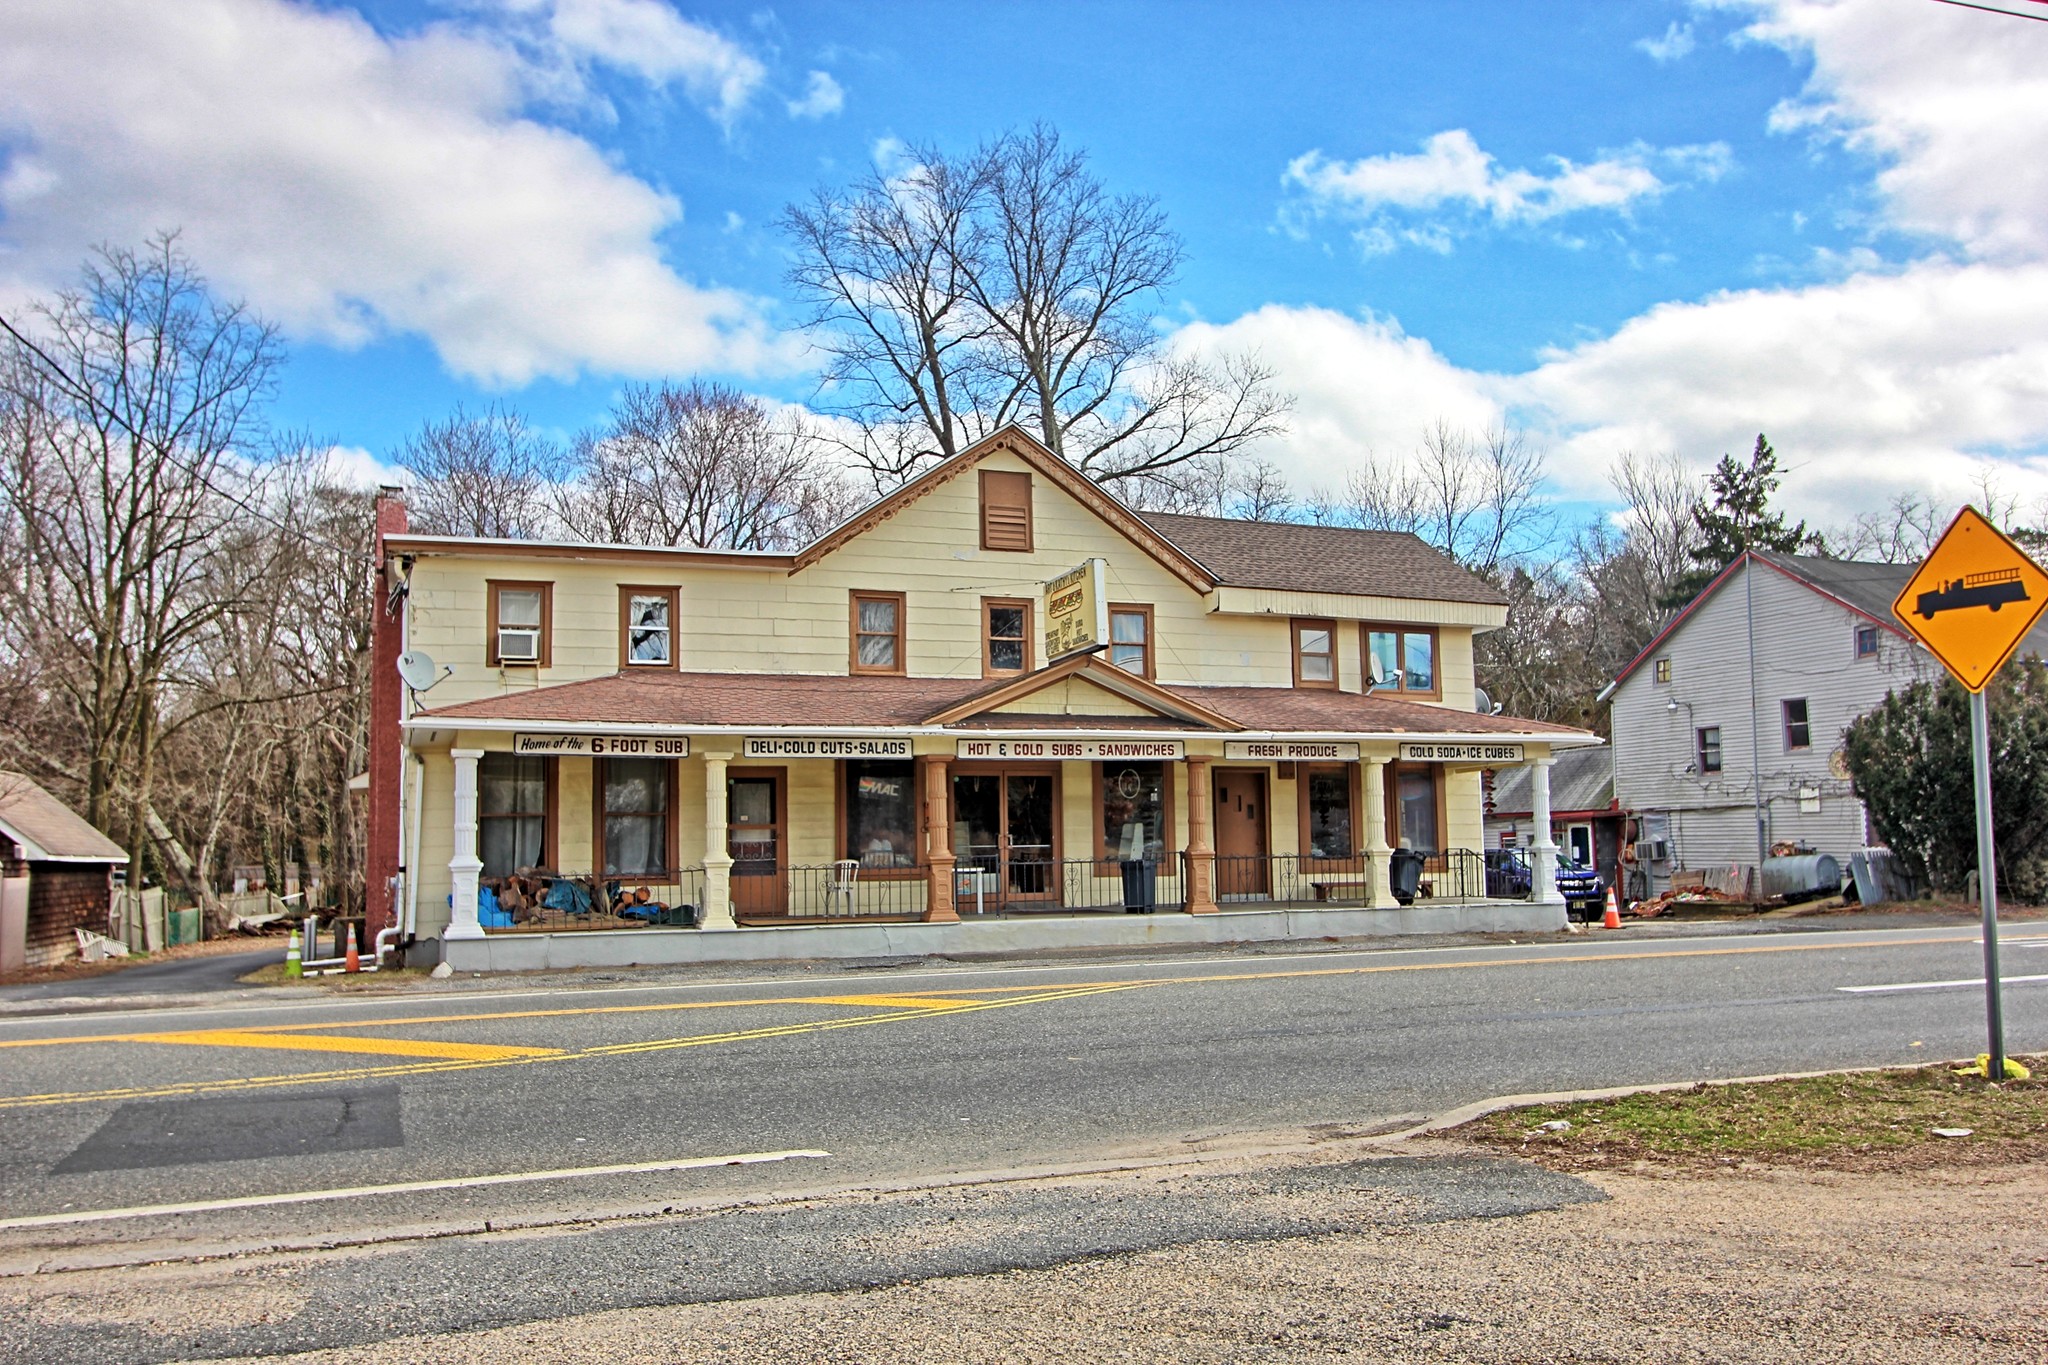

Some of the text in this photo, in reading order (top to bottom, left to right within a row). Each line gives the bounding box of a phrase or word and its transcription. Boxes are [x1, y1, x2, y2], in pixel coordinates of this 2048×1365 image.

[521, 737, 683, 754] Home of the 6 FOOT SUB
[968, 743, 1175, 756] HOT & COLD SUBS SANDWICHES
[1248, 745, 1337, 757] FRESH PRODUCE
[1410, 747, 1433, 757] COLD
[1485, 748, 1515, 758] CUBES
[868, 782, 899, 796] MAC
